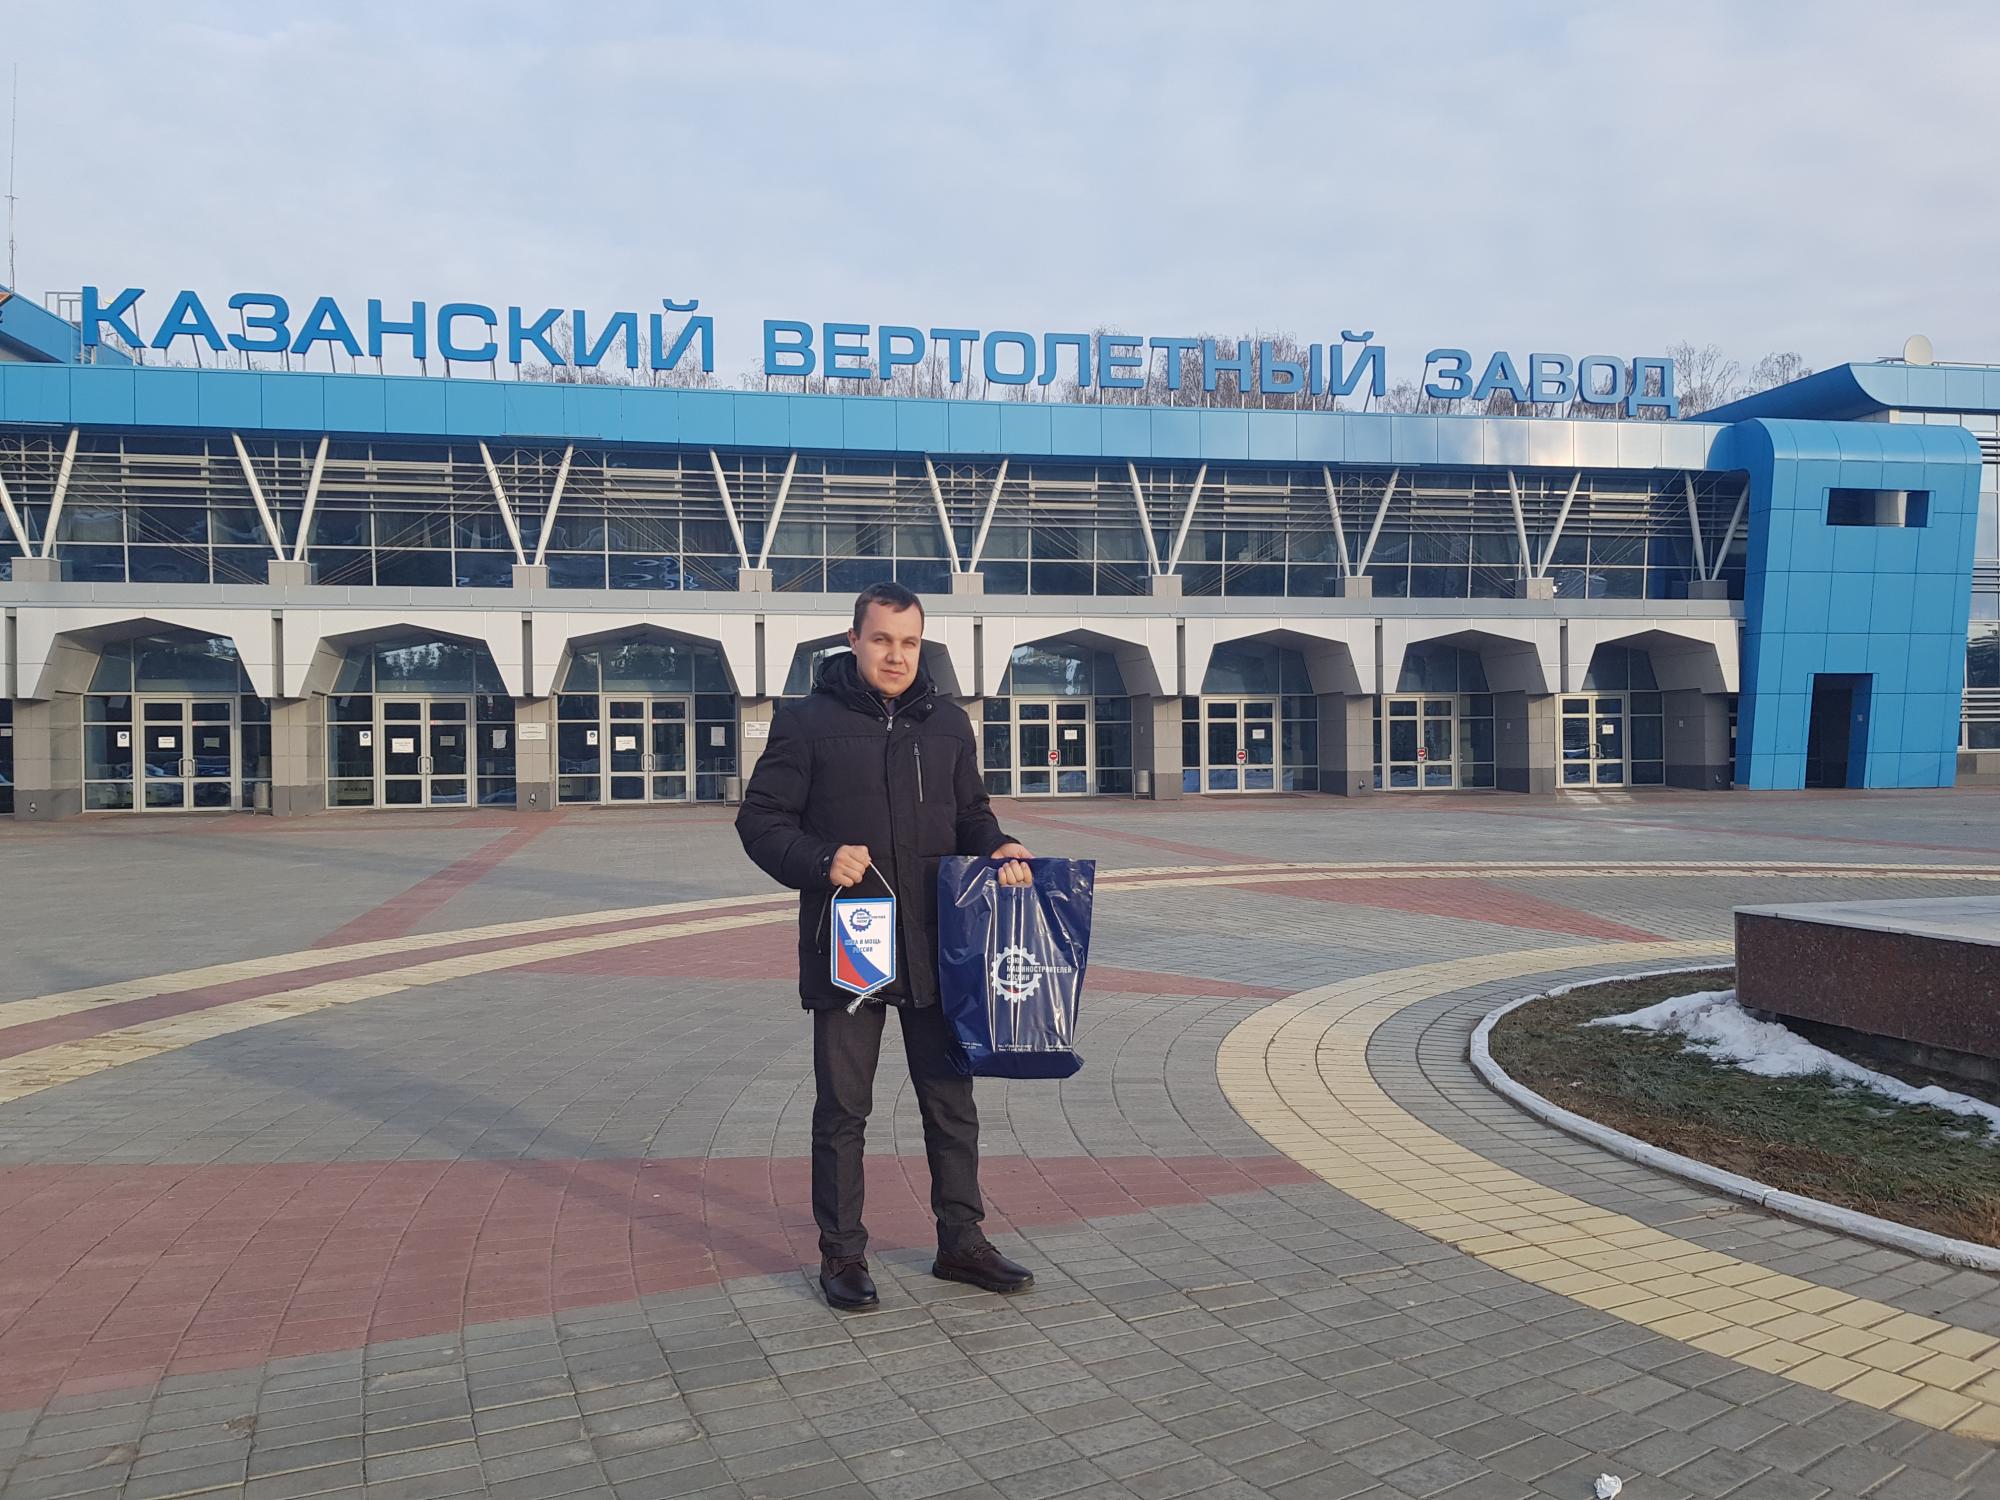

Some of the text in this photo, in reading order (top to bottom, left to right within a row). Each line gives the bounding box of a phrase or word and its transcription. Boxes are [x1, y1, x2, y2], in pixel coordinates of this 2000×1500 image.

[82, 286, 1680, 418] КАЗАНСКИЙ ВЕРТОЛЕТНЫЙ ЗАВОД
